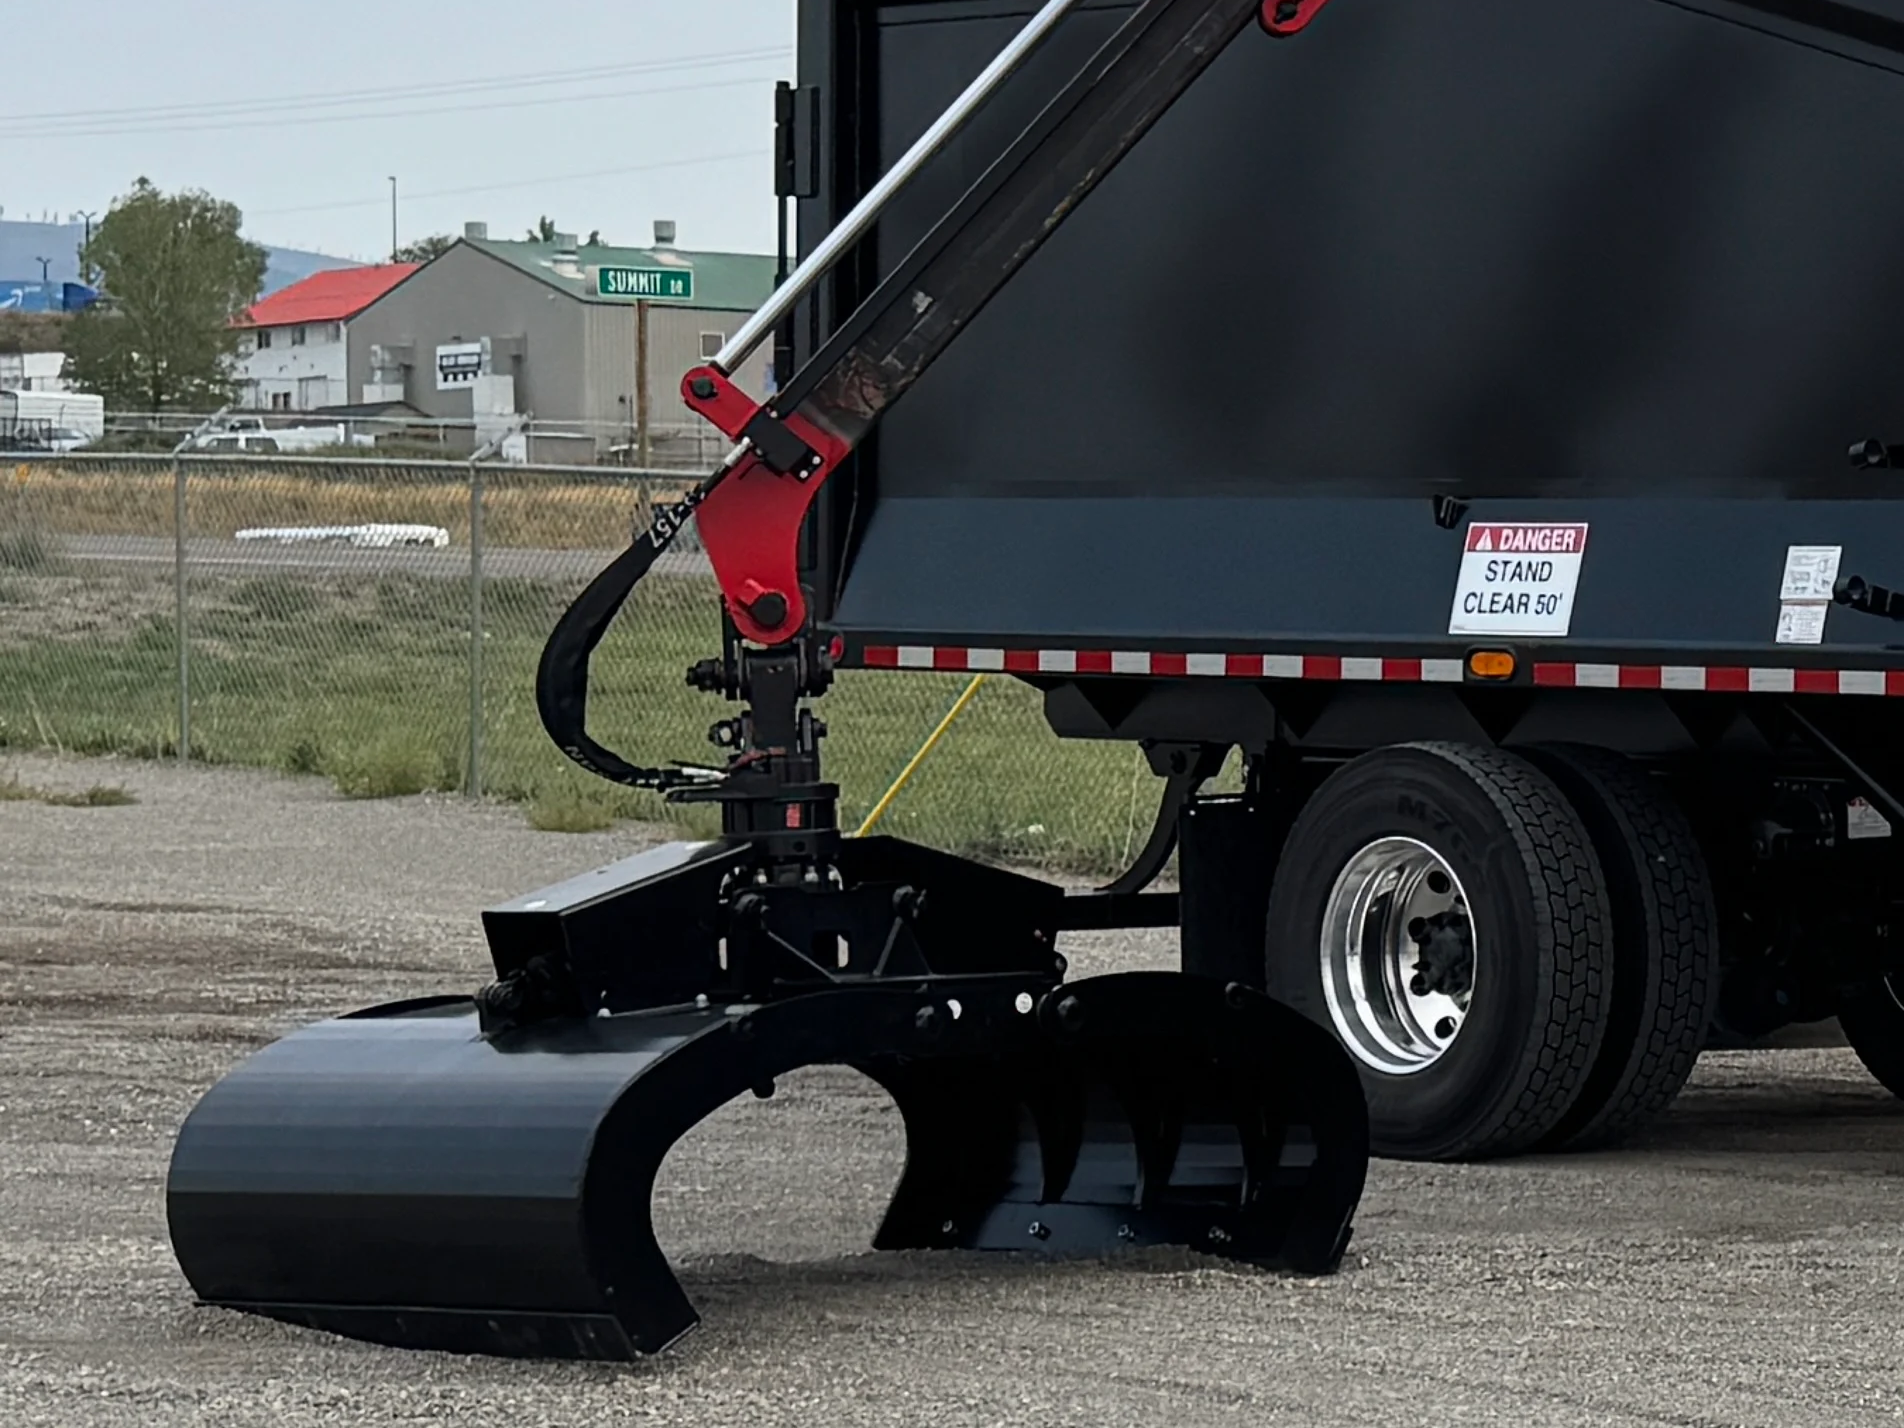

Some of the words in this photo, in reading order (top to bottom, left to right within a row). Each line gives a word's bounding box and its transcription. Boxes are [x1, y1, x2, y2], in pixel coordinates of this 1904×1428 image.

[607, 270, 661, 294] SUMMIT
[1499, 528, 1577, 551] DANGER
[1484, 560, 1553, 582] STAND
[1463, 591, 1531, 614] CLEAR
[1534, 593, 1563, 615] 50'
